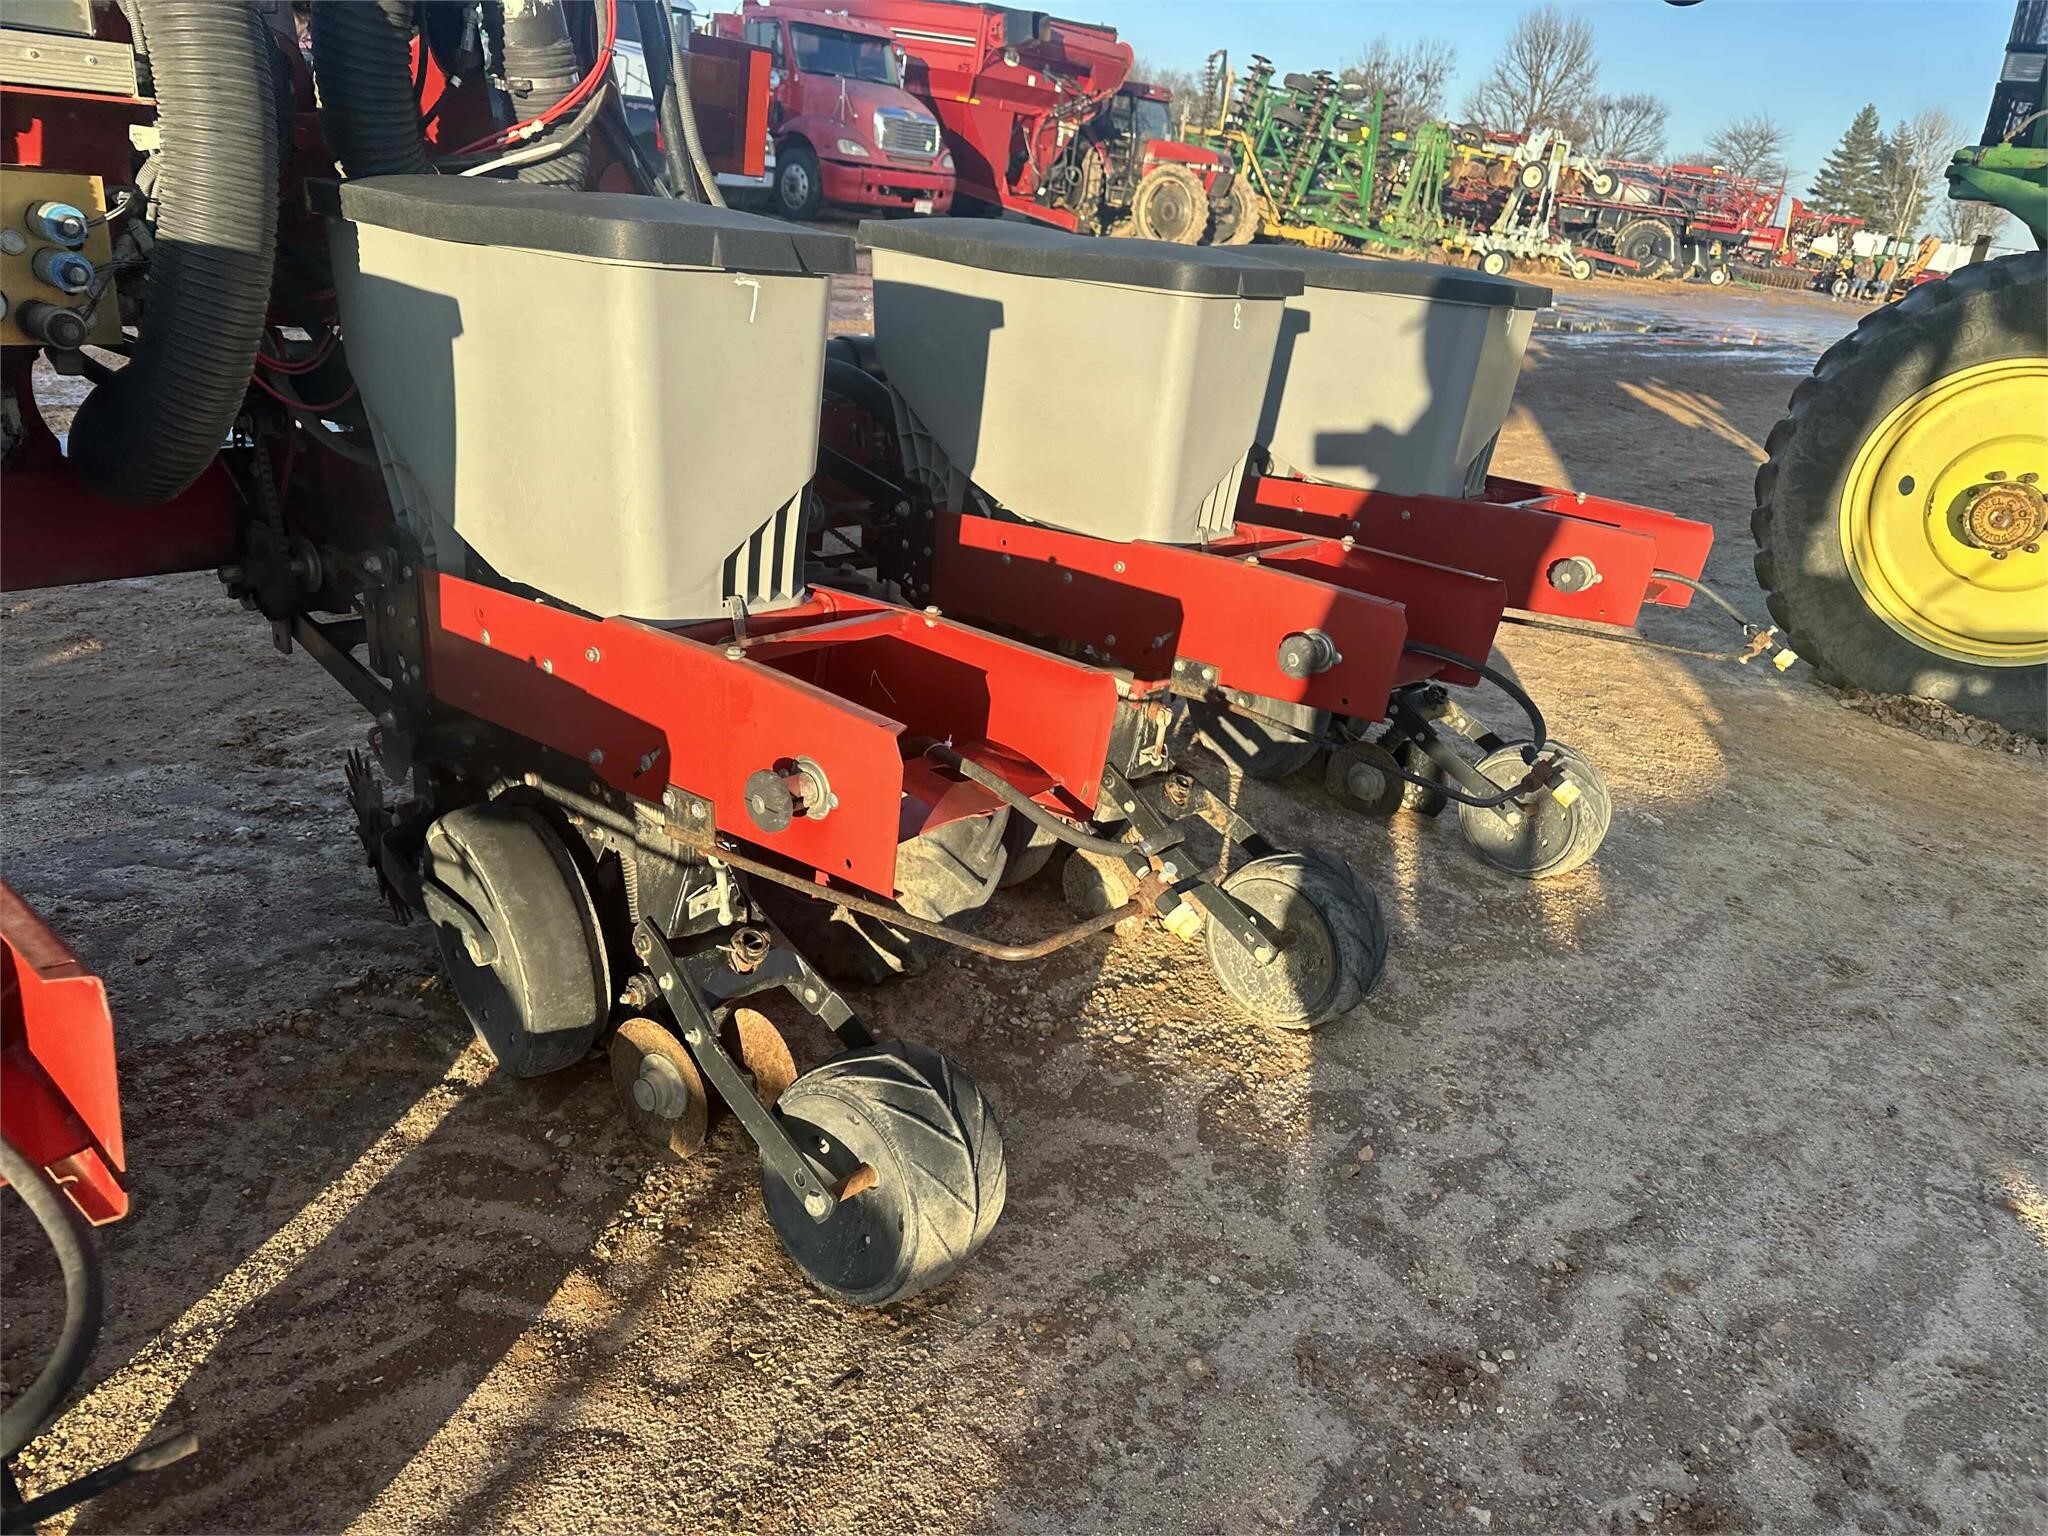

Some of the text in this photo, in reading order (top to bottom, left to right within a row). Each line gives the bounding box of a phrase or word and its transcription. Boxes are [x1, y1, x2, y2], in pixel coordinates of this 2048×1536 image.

[733, 278, 761, 323] 7
[1233, 302, 1242, 330] 8
[1505, 308, 1515, 336] 9
